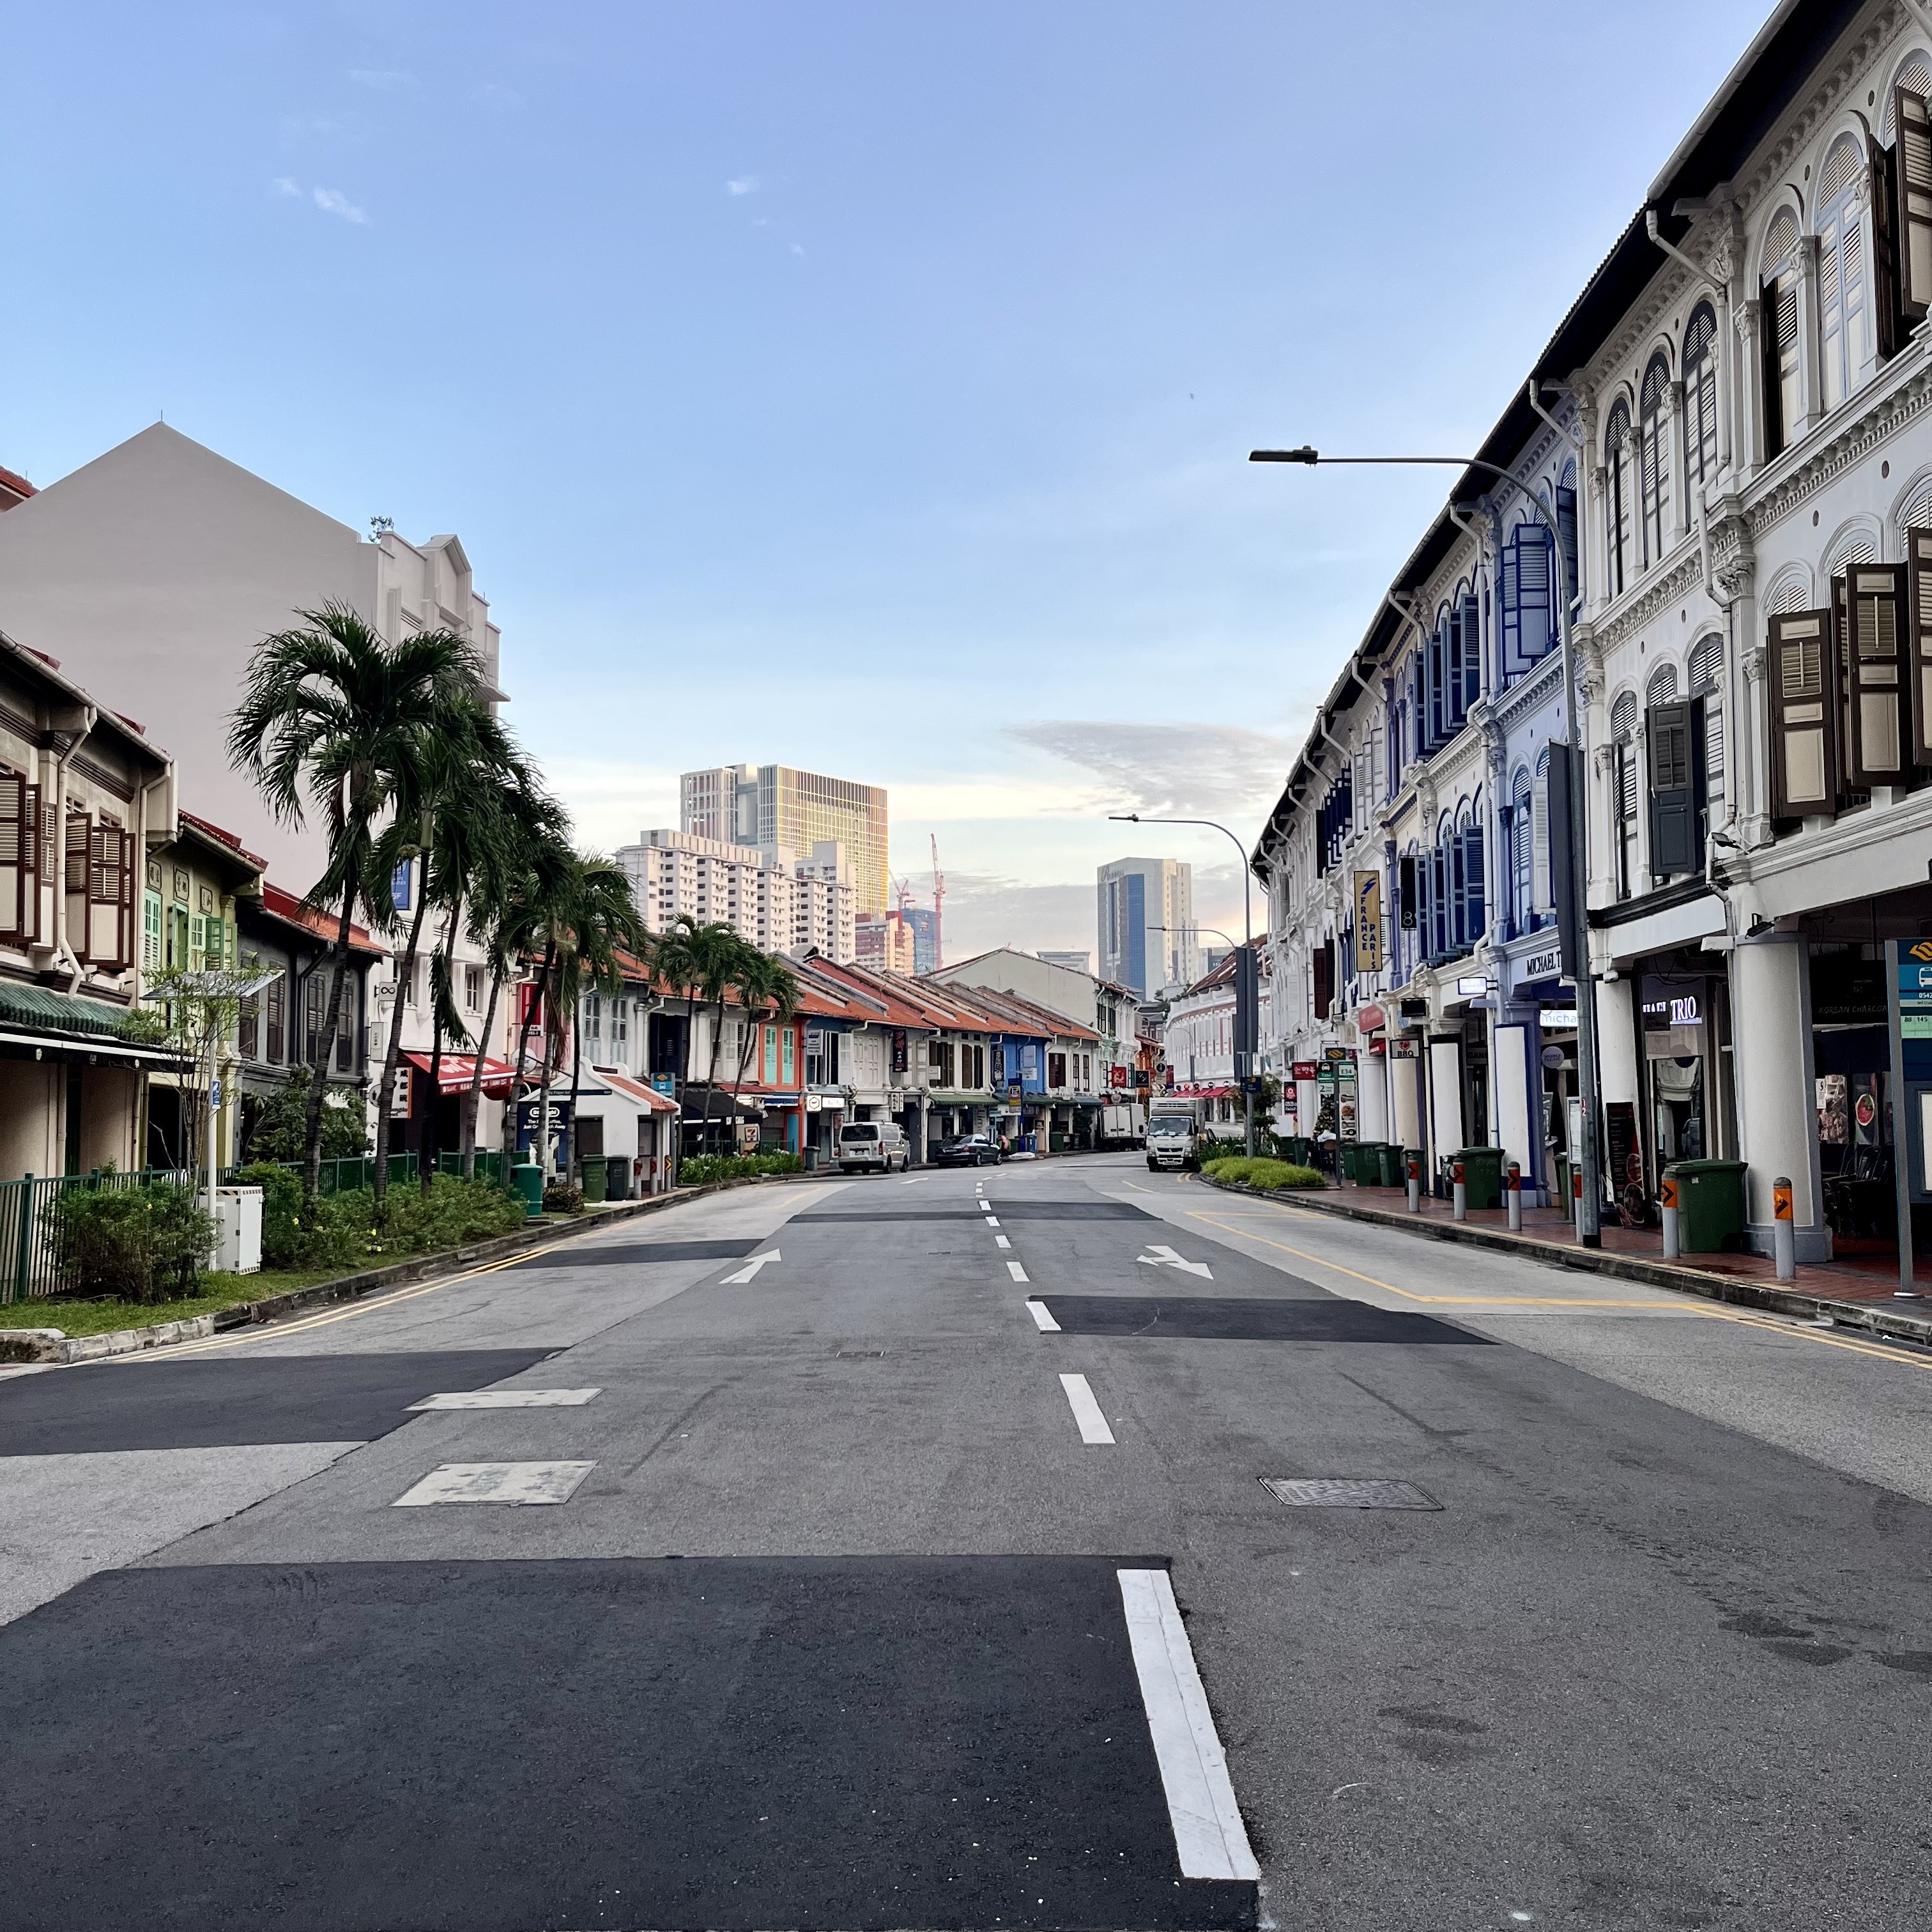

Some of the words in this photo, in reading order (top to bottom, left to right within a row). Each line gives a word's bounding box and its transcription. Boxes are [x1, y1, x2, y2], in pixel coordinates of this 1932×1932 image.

[1526, 952, 1556, 976] MICHAEL
[1670, 996, 1696, 1021] TRIO
[1818, 1006, 1850, 1014] KOREAN
